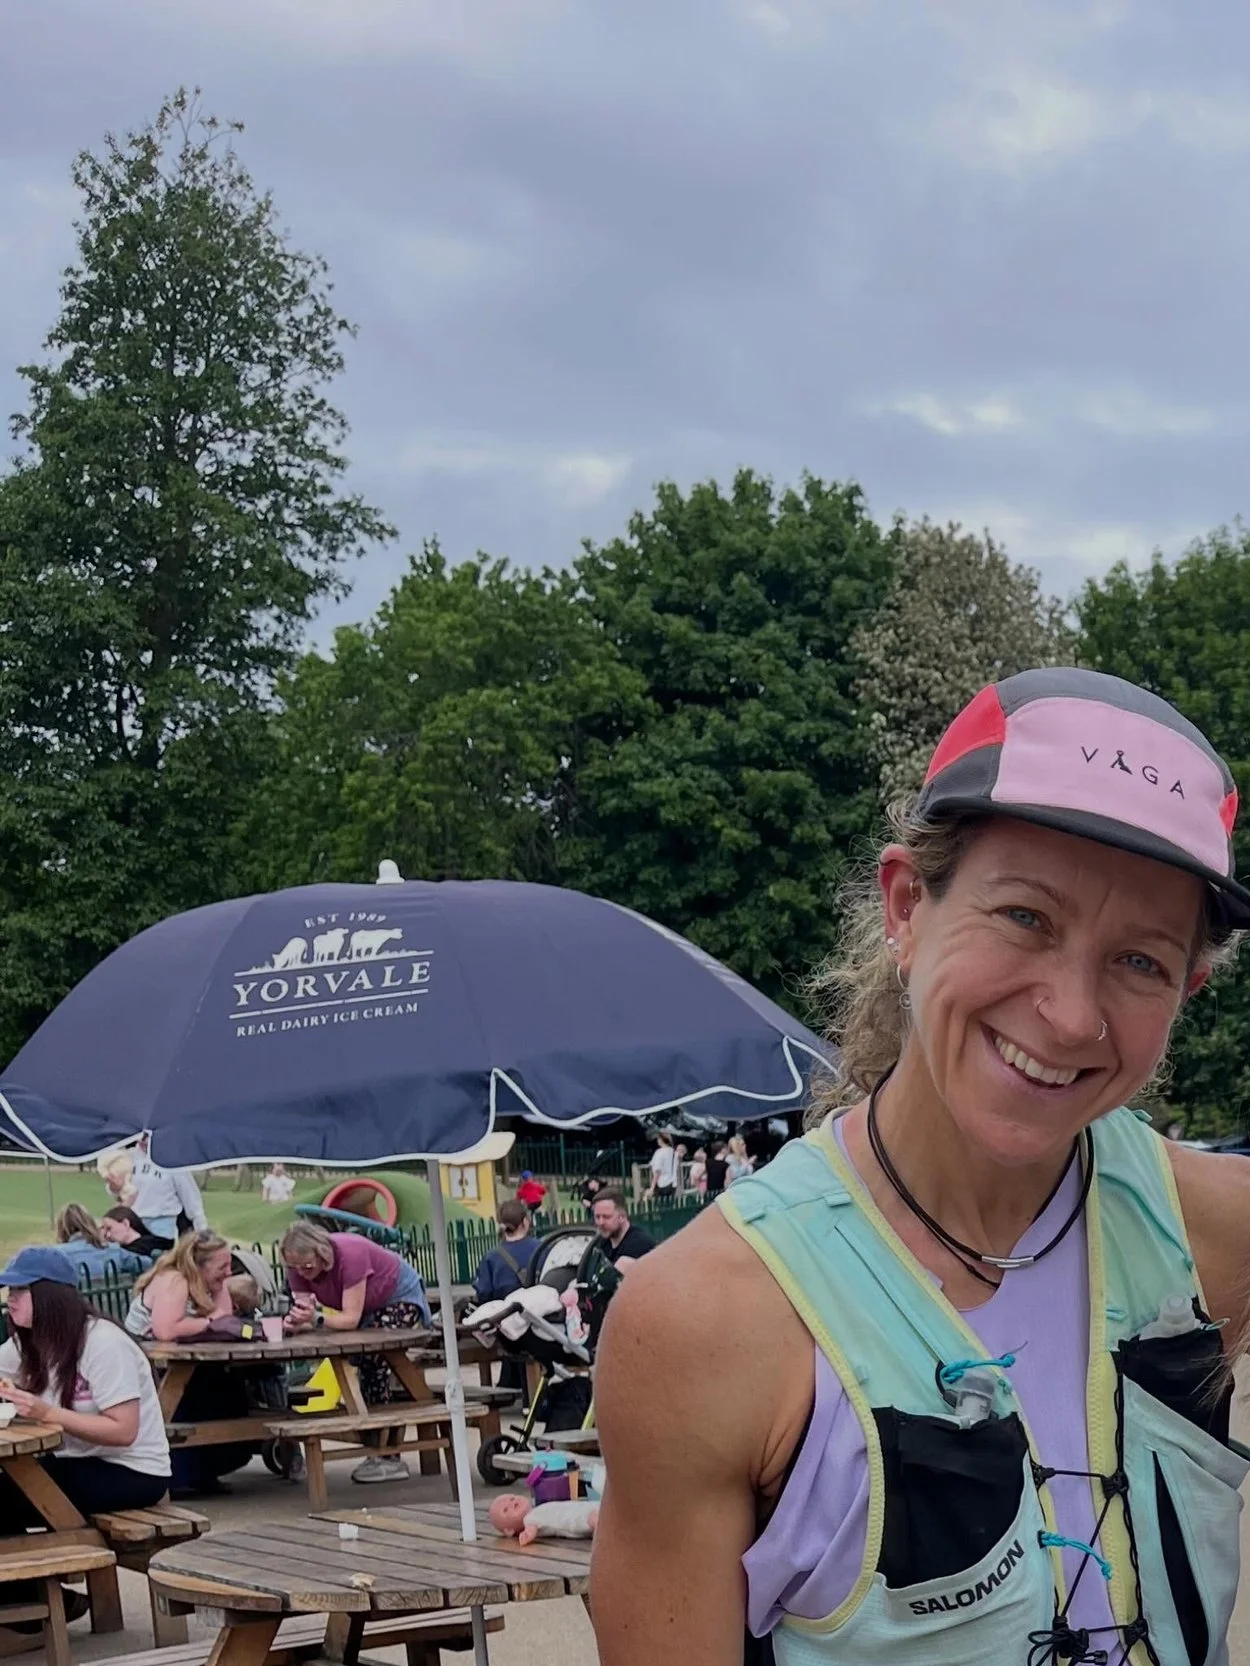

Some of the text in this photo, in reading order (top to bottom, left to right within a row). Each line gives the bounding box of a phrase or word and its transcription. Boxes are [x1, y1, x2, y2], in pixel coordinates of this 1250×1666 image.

[304, 912, 340, 928] EST
[233, 961, 431, 1007] YORVALE
[236, 1002, 419, 1037] REAL DAIRY ICE CREAM
[909, 1540, 1025, 1615] SALOMON
